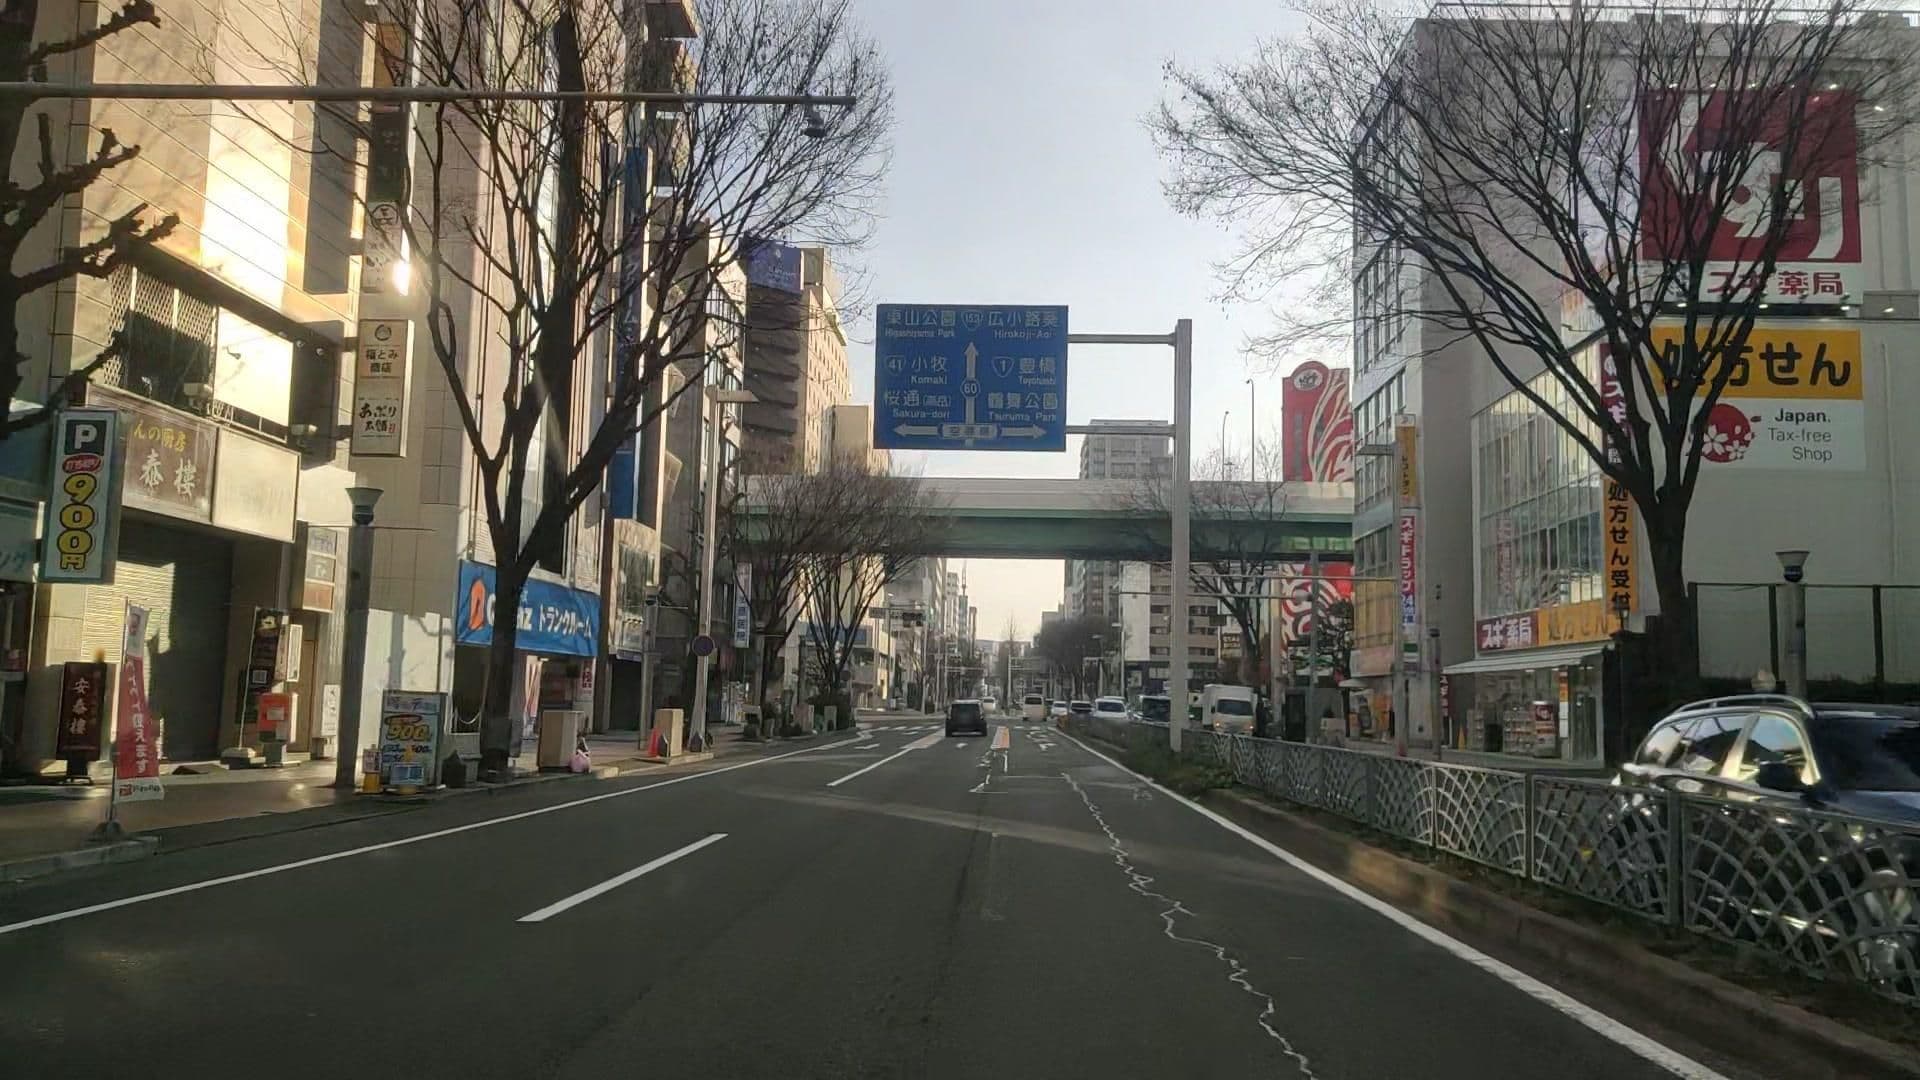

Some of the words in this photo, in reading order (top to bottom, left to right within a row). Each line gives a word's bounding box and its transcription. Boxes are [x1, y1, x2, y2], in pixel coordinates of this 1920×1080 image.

[888, 358, 904, 369] 41
[910, 355, 948, 373] 小牧
[1000, 359, 1006, 372] 1
[911, 375, 947, 385] Komaki
[964, 383, 978, 394] 60
[893, 409, 950, 419] Sakura-dori
[1035, 412, 1057, 422] Park
[1774, 407, 1832, 427] Japan.
[74, 424, 98, 450] P
[1767, 427, 1832, 443] Tax-free
[1791, 447, 1833, 464] Shop
[57, 472, 98, 571] 900円
[538, 603, 593, 639] トランクルーム
[1481, 616, 1531, 649] スギ薬局
